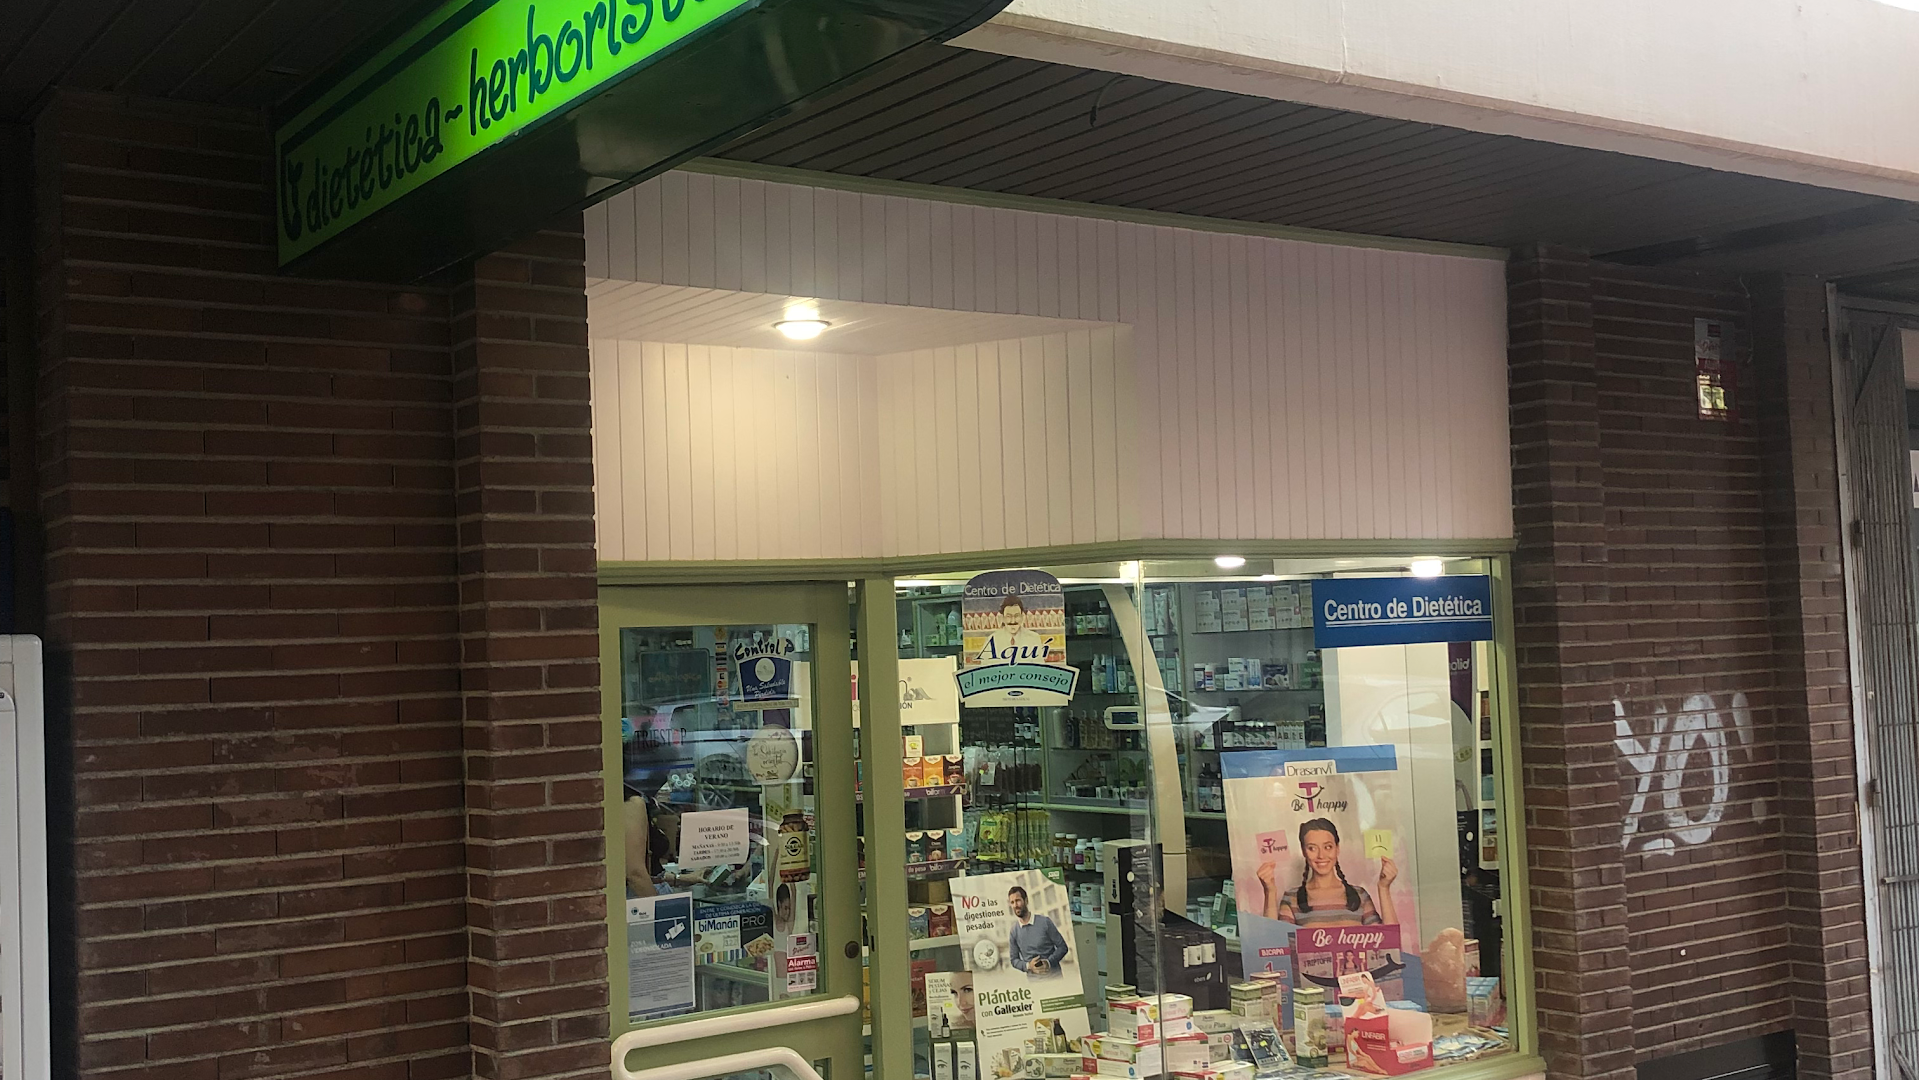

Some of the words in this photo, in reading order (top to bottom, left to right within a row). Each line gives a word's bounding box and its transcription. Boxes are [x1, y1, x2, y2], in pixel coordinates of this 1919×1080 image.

[469, 0, 705, 136] herboris
[964, 584, 998, 596] Centro
[1001, 582, 1016, 594] de
[1019, 581, 1061, 594] Dietética
[1324, 599, 1382, 621] Centro
[1386, 597, 1408, 618] de
[1412, 594, 1483, 617] Dietética
[734, 637, 781, 661] Control
[974, 635, 1054, 666] Aquí
[964, 672, 974, 689] el
[979, 671, 1016, 685] mejor
[1019, 671, 1069, 687] consejo
[1287, 763, 1333, 777] Drasanvi
[1291, 799, 1306, 812] Be
[1316, 799, 1348, 812] happy
[698, 825, 725, 833] HORARIO
[704, 832, 729, 840] VERANO
[962, 895, 980, 909] NO
[987, 899, 998, 907] las
[698, 918, 739, 932] biManán
[741, 914, 766, 927] PRO
[964, 910, 1005, 921] digestiones
[966, 921, 994, 932] pesadas
[1312, 929, 1333, 947] Be
[1337, 928, 1385, 949] happy
[788, 959, 816, 967] Alarma
[978, 988, 1032, 1006] Plántate
[981, 1010, 993, 1018] con
[994, 1002, 1034, 1016] Gallexier
